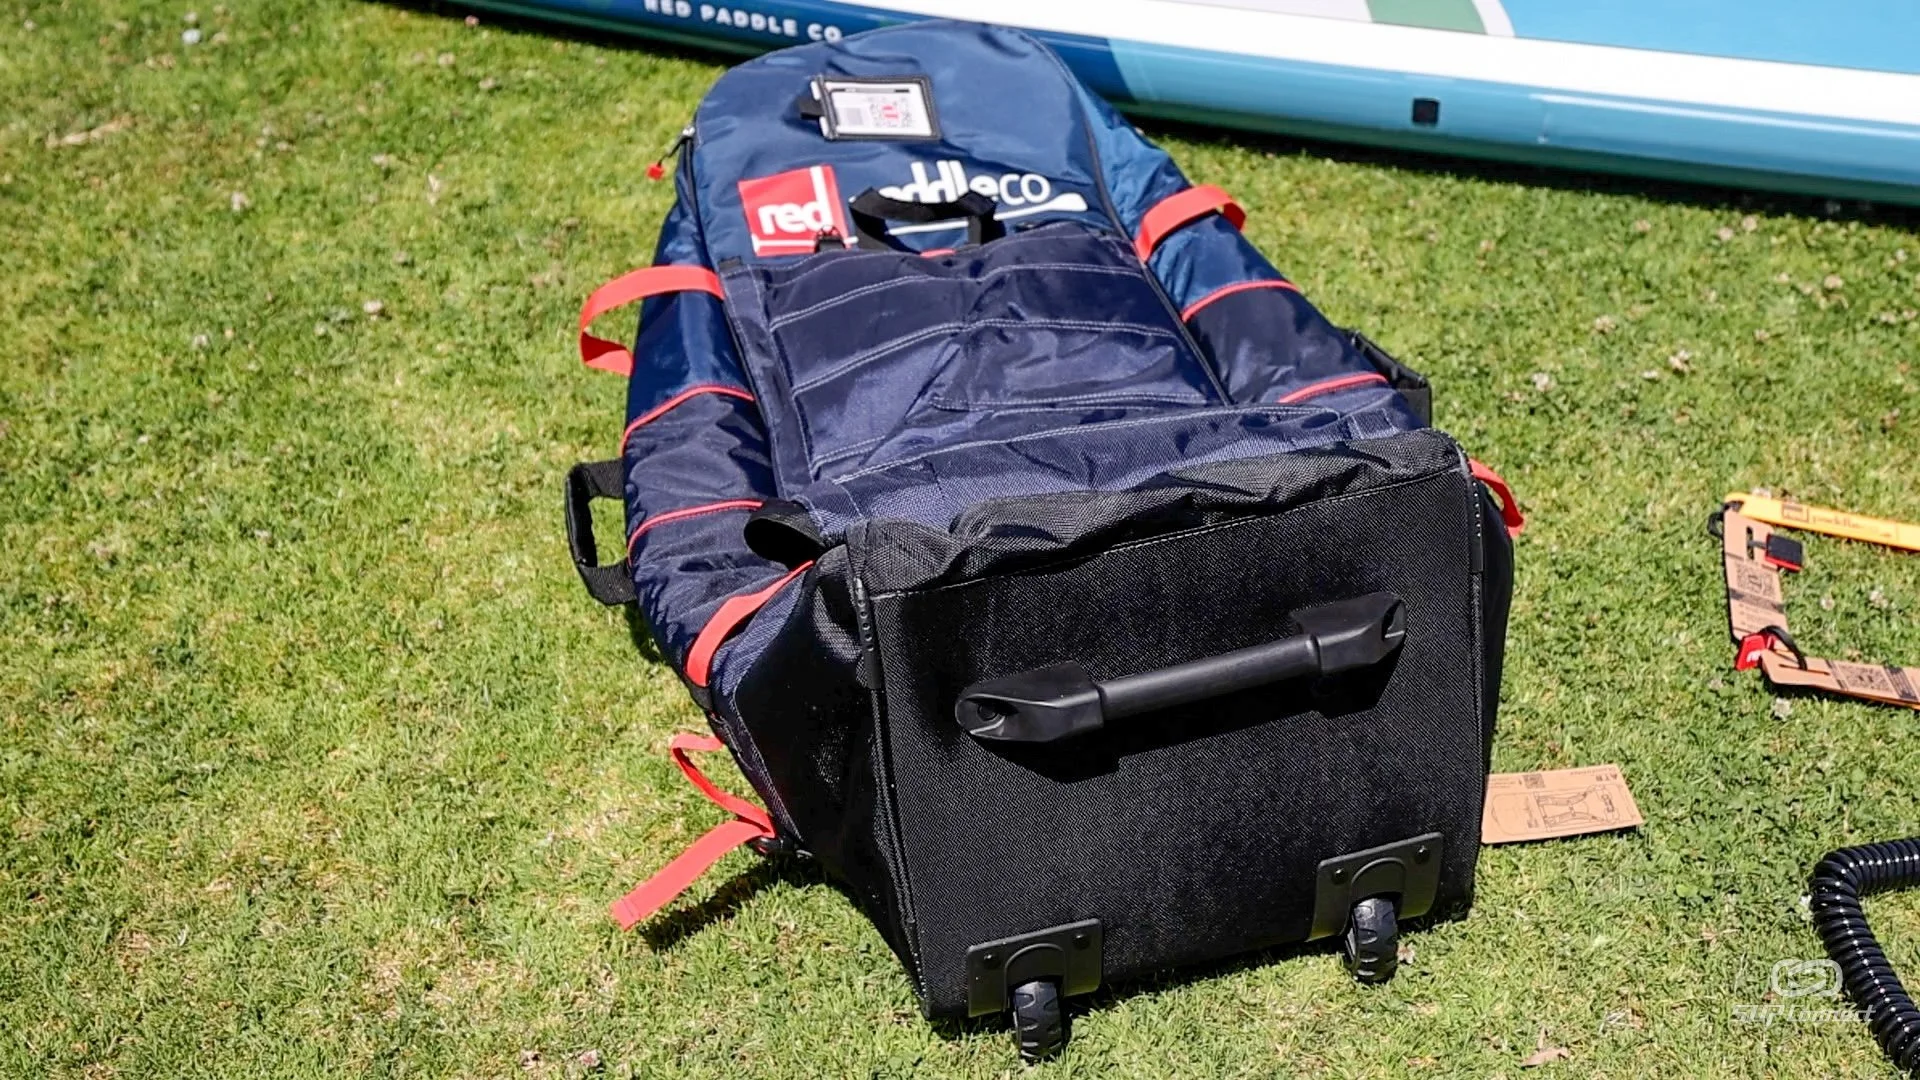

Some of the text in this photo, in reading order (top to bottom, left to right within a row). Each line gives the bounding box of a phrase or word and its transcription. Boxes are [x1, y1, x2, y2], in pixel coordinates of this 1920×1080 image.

[643, 0, 842, 43] RED PADDLE CO
[758, 166, 834, 235] red
